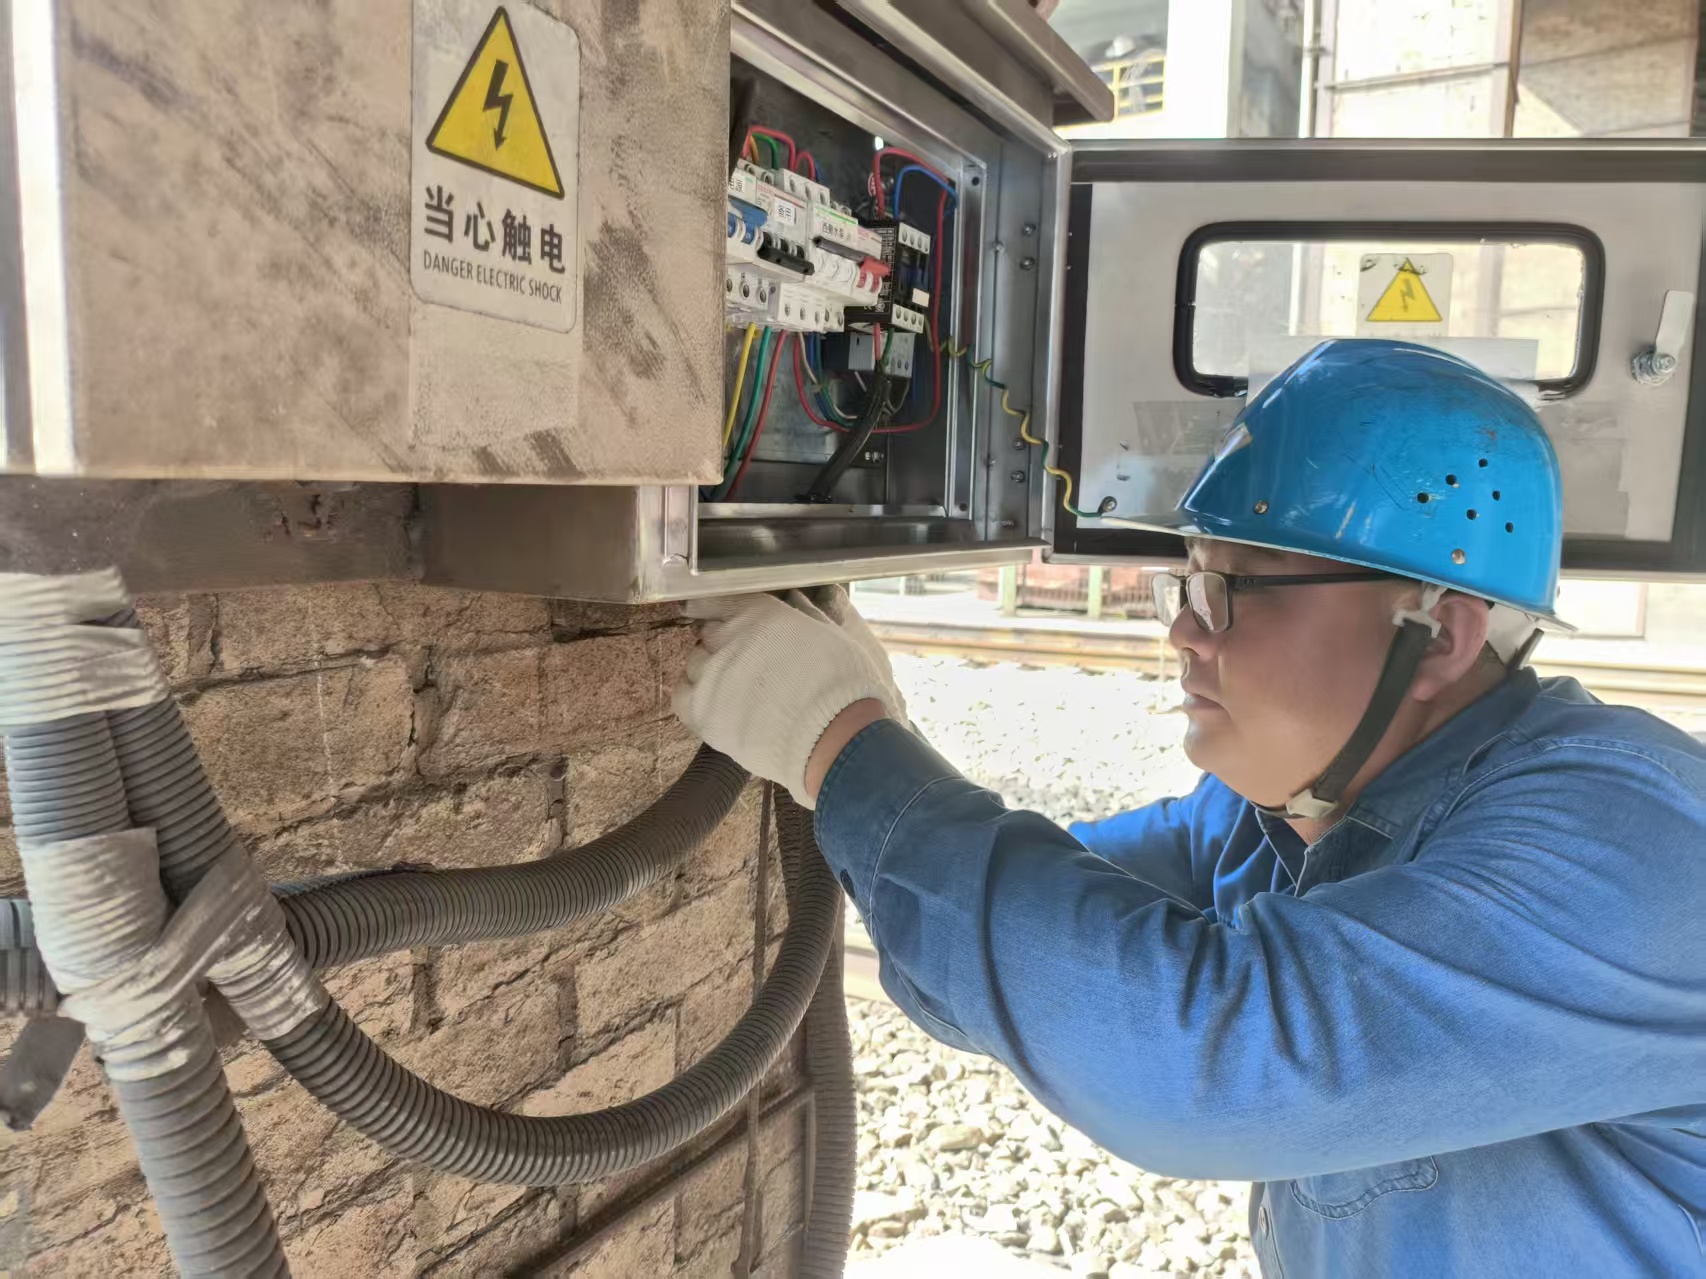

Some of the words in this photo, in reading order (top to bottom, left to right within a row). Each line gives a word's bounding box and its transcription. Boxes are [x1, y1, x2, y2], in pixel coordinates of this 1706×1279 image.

[424, 185, 566, 275] 当心触电
[423, 249, 474, 281] DANGER
[475, 264, 526, 296] ELECTRIC
[528, 279, 563, 304] SHOCK
